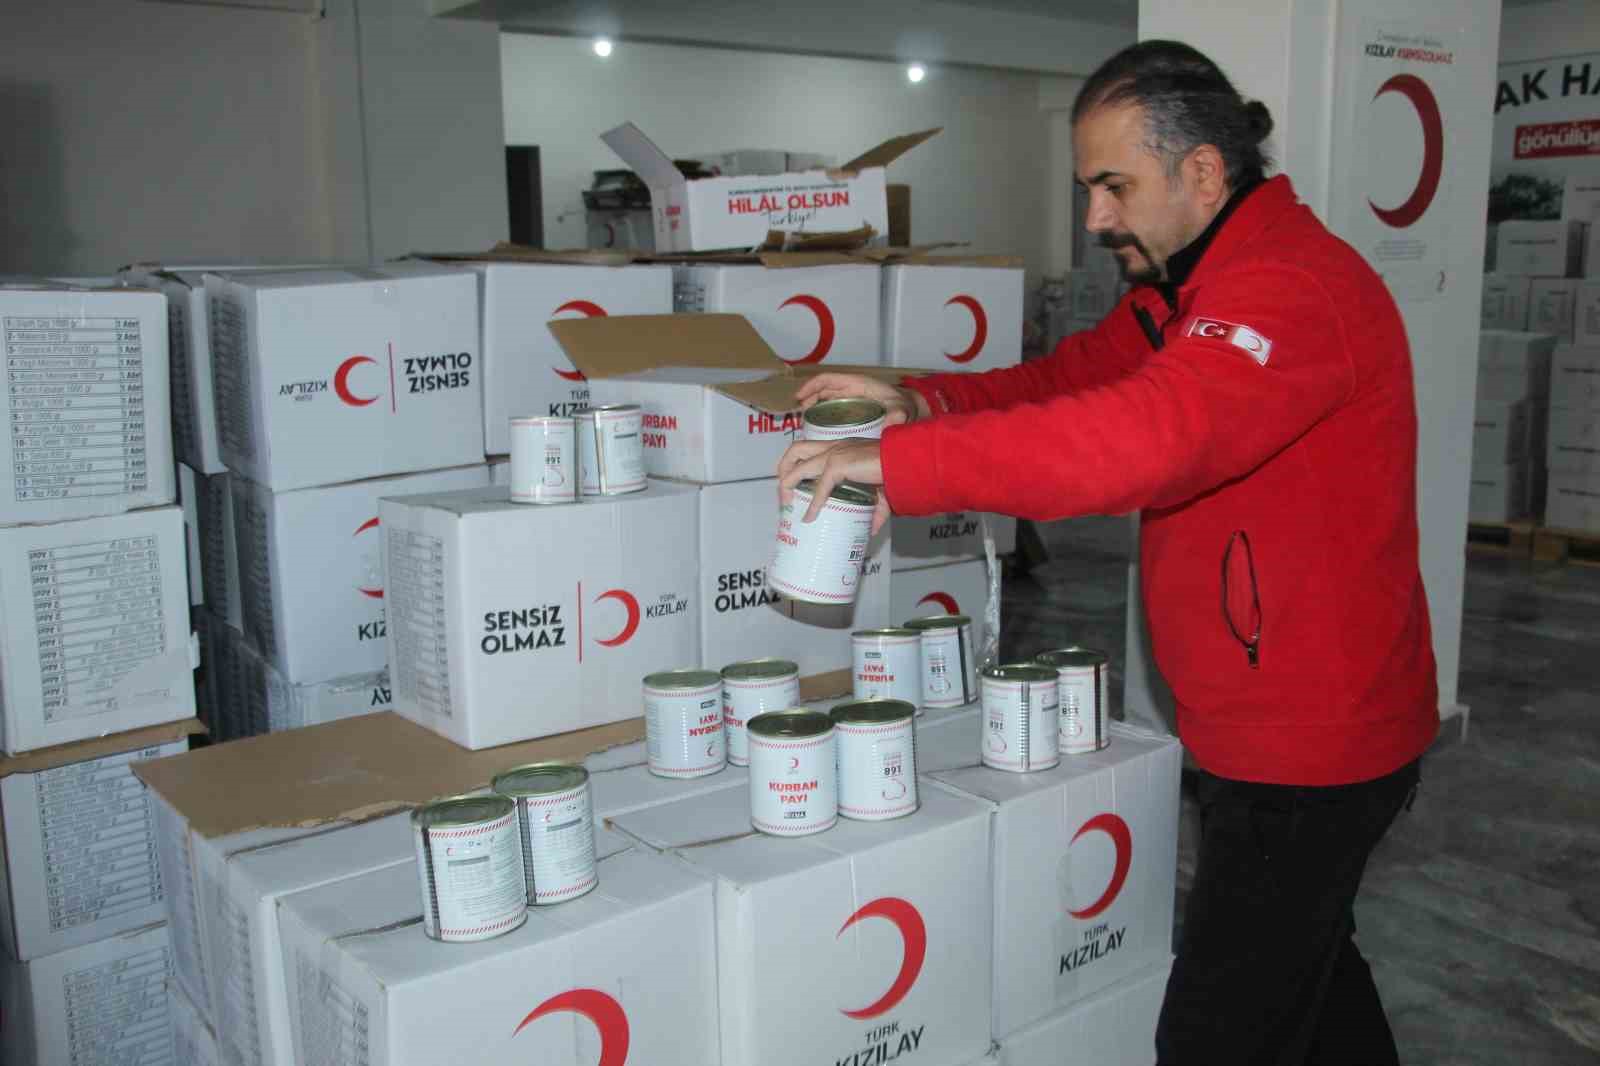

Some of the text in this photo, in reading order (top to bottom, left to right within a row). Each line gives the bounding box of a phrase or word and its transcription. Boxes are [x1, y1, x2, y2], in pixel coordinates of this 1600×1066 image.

[787, 192, 849, 210] OLSUN
[404, 352, 472, 375] OLMAZ
[279, 380, 328, 396] KIZILAY
[929, 521, 979, 540] KIZILAY
[646, 600, 689, 618] KIZILAY
[481, 627, 566, 655] OLMAZ
[768, 780, 818, 792] KURBAN
[780, 794, 808, 804] PAYI
[1059, 927, 1126, 976] KIZILAY
